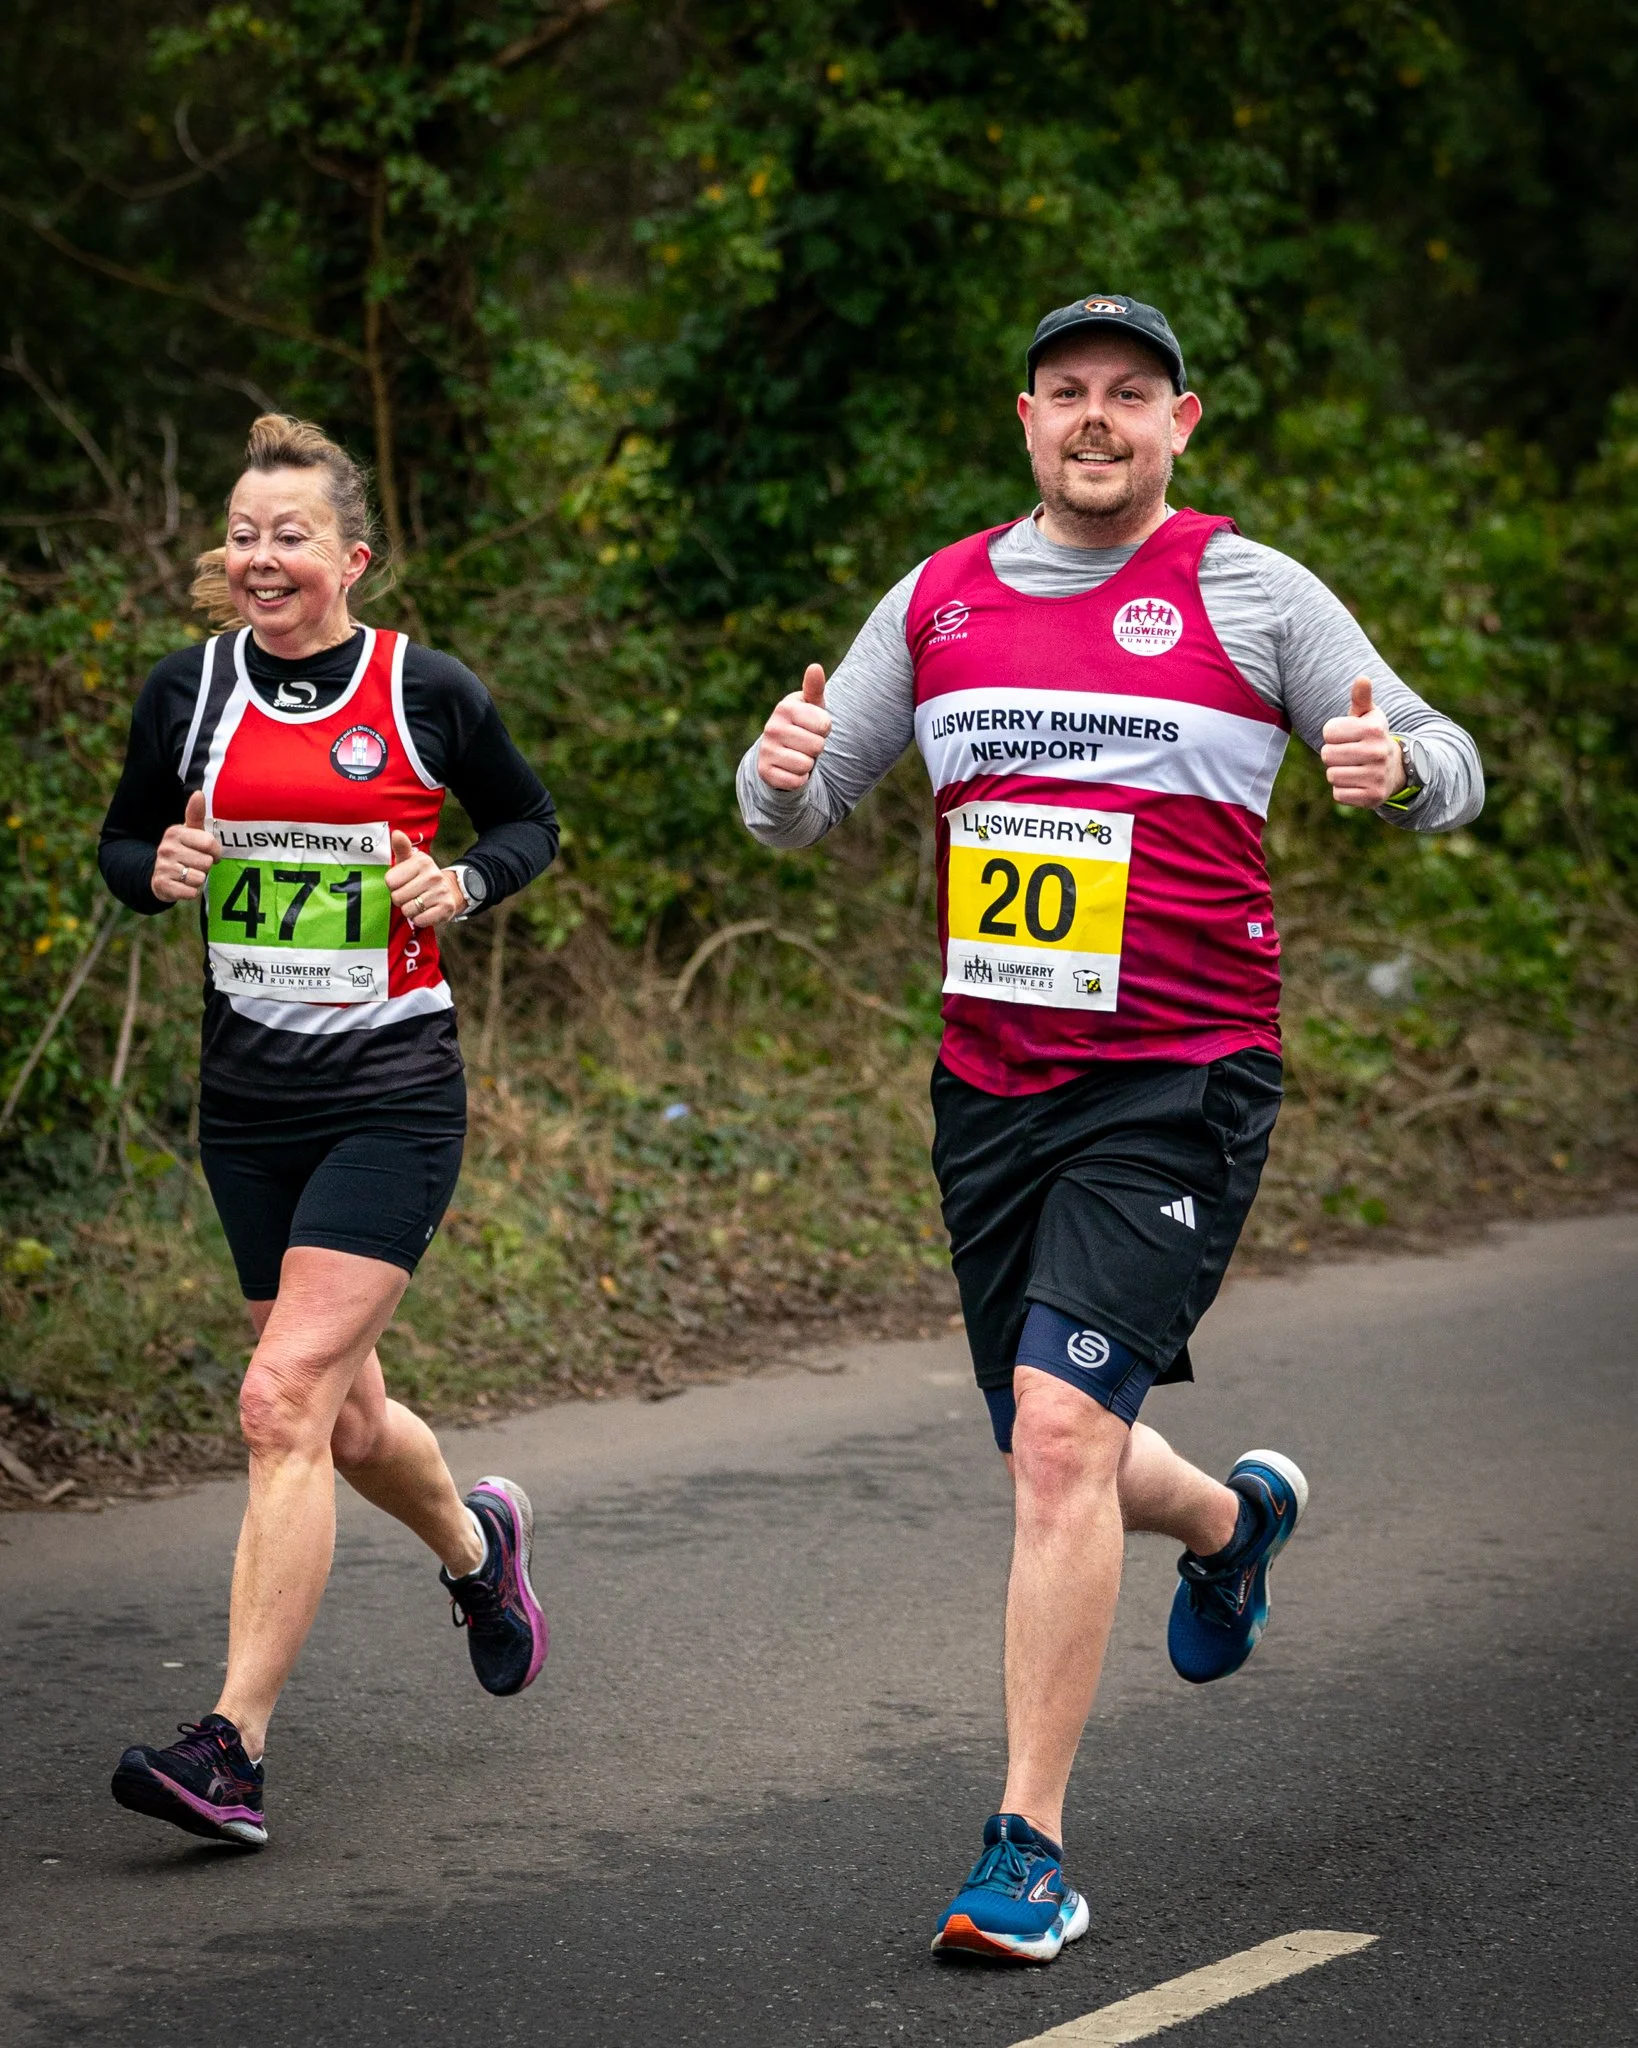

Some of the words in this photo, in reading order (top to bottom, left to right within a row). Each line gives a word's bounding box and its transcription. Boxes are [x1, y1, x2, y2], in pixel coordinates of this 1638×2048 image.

[1120, 626, 1177, 637] LLISWERRY
[1119, 637, 1174, 646] RUNNERS
[932, 710, 1044, 740] LLISWERRY
[1051, 712, 1179, 742] RUNNERS
[970, 740, 1103, 762] NEWPORT
[962, 813, 1087, 843] LLISWERRY
[1098, 825, 1112, 845] 8
[220, 831, 353, 852] LLISWERRY
[360, 836, 374, 853] 8
[221, 867, 362, 943] 471
[979, 857, 1077, 942] 20
[270, 964, 331, 976] LLISWERRY
[354, 974, 367, 984] XS
[998, 962, 1055, 978] LLISWERRY
[270, 977, 331, 987] RUNNERS
